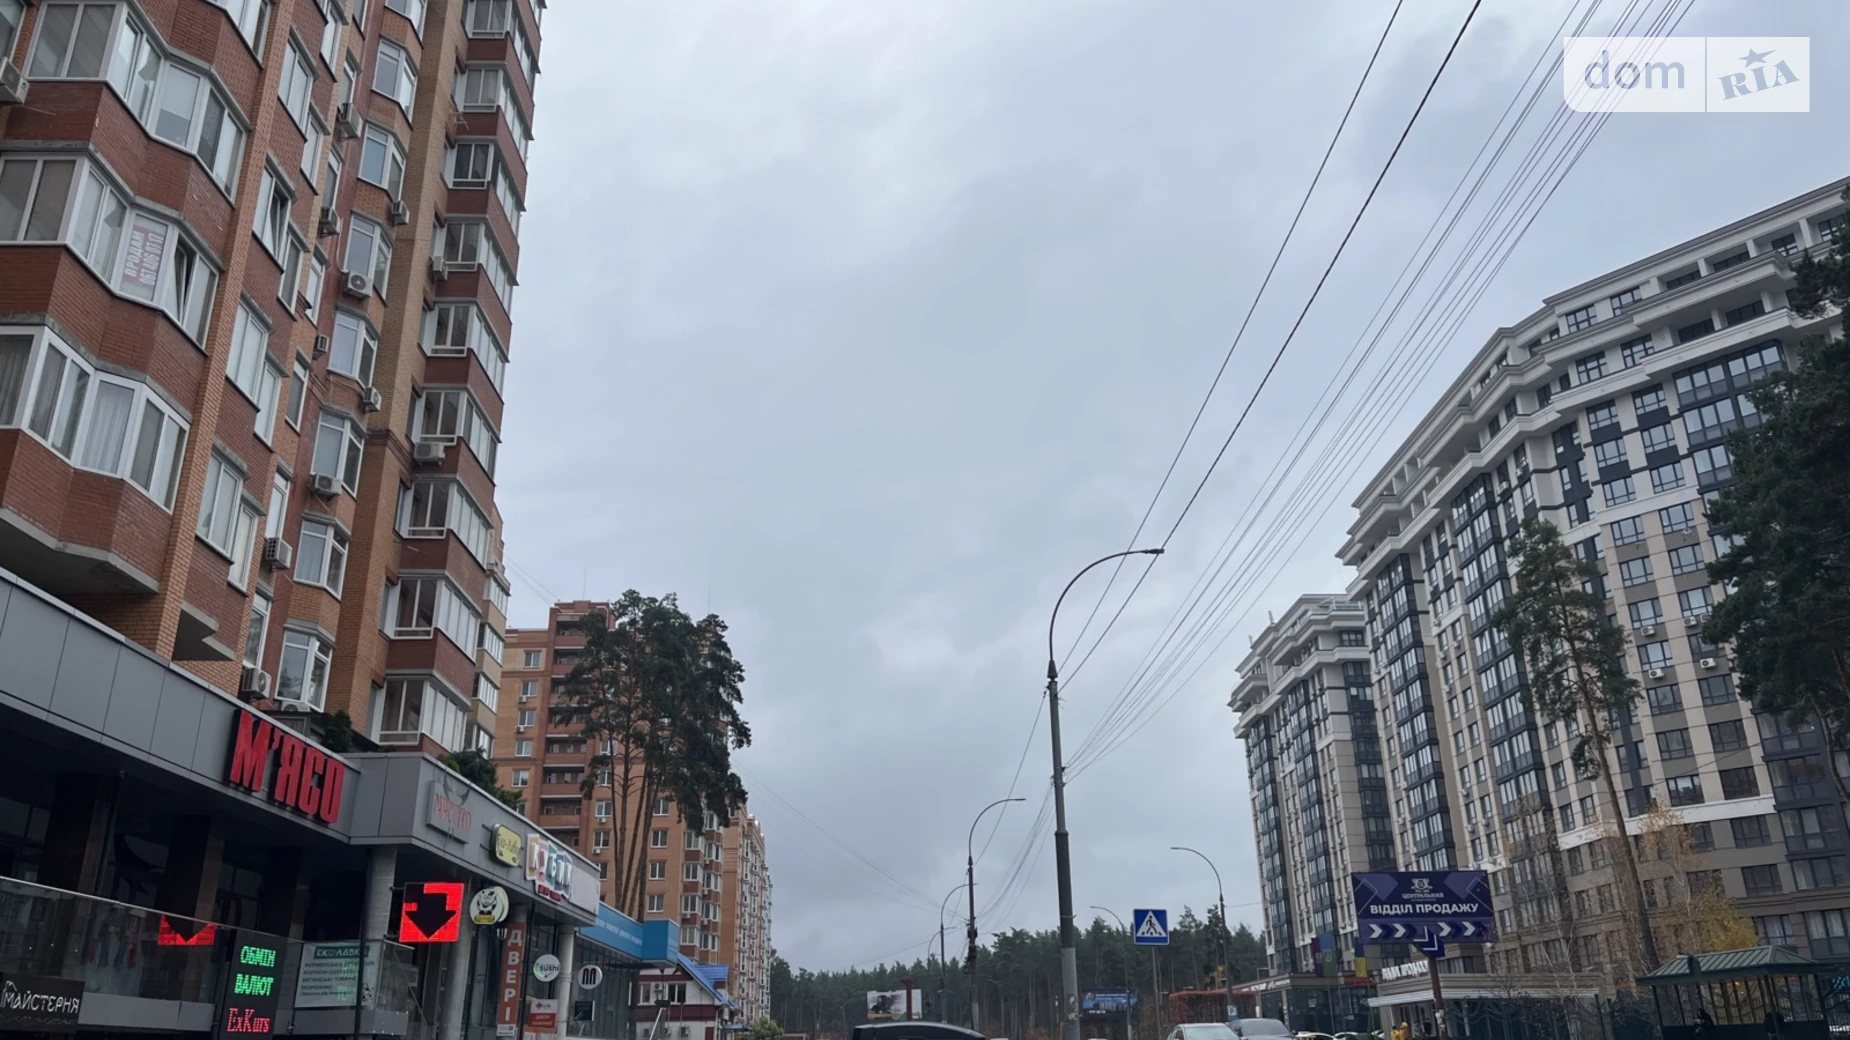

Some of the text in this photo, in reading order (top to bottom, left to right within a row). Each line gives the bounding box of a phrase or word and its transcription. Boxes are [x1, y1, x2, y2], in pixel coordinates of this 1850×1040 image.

[124, 230, 145, 278] ПРОДАМ
[230, 709, 345, 824] М'ЯСО
[1370, 903, 1479, 915] ВІДДІЛ ПРОДАЖУ
[240, 946, 276, 967] ОБМІН
[234, 973, 275, 996] ВАЛЮТ
[504, 929, 522, 1022] ДВЕРІ
[227, 1007, 270, 1032] ExKurs
